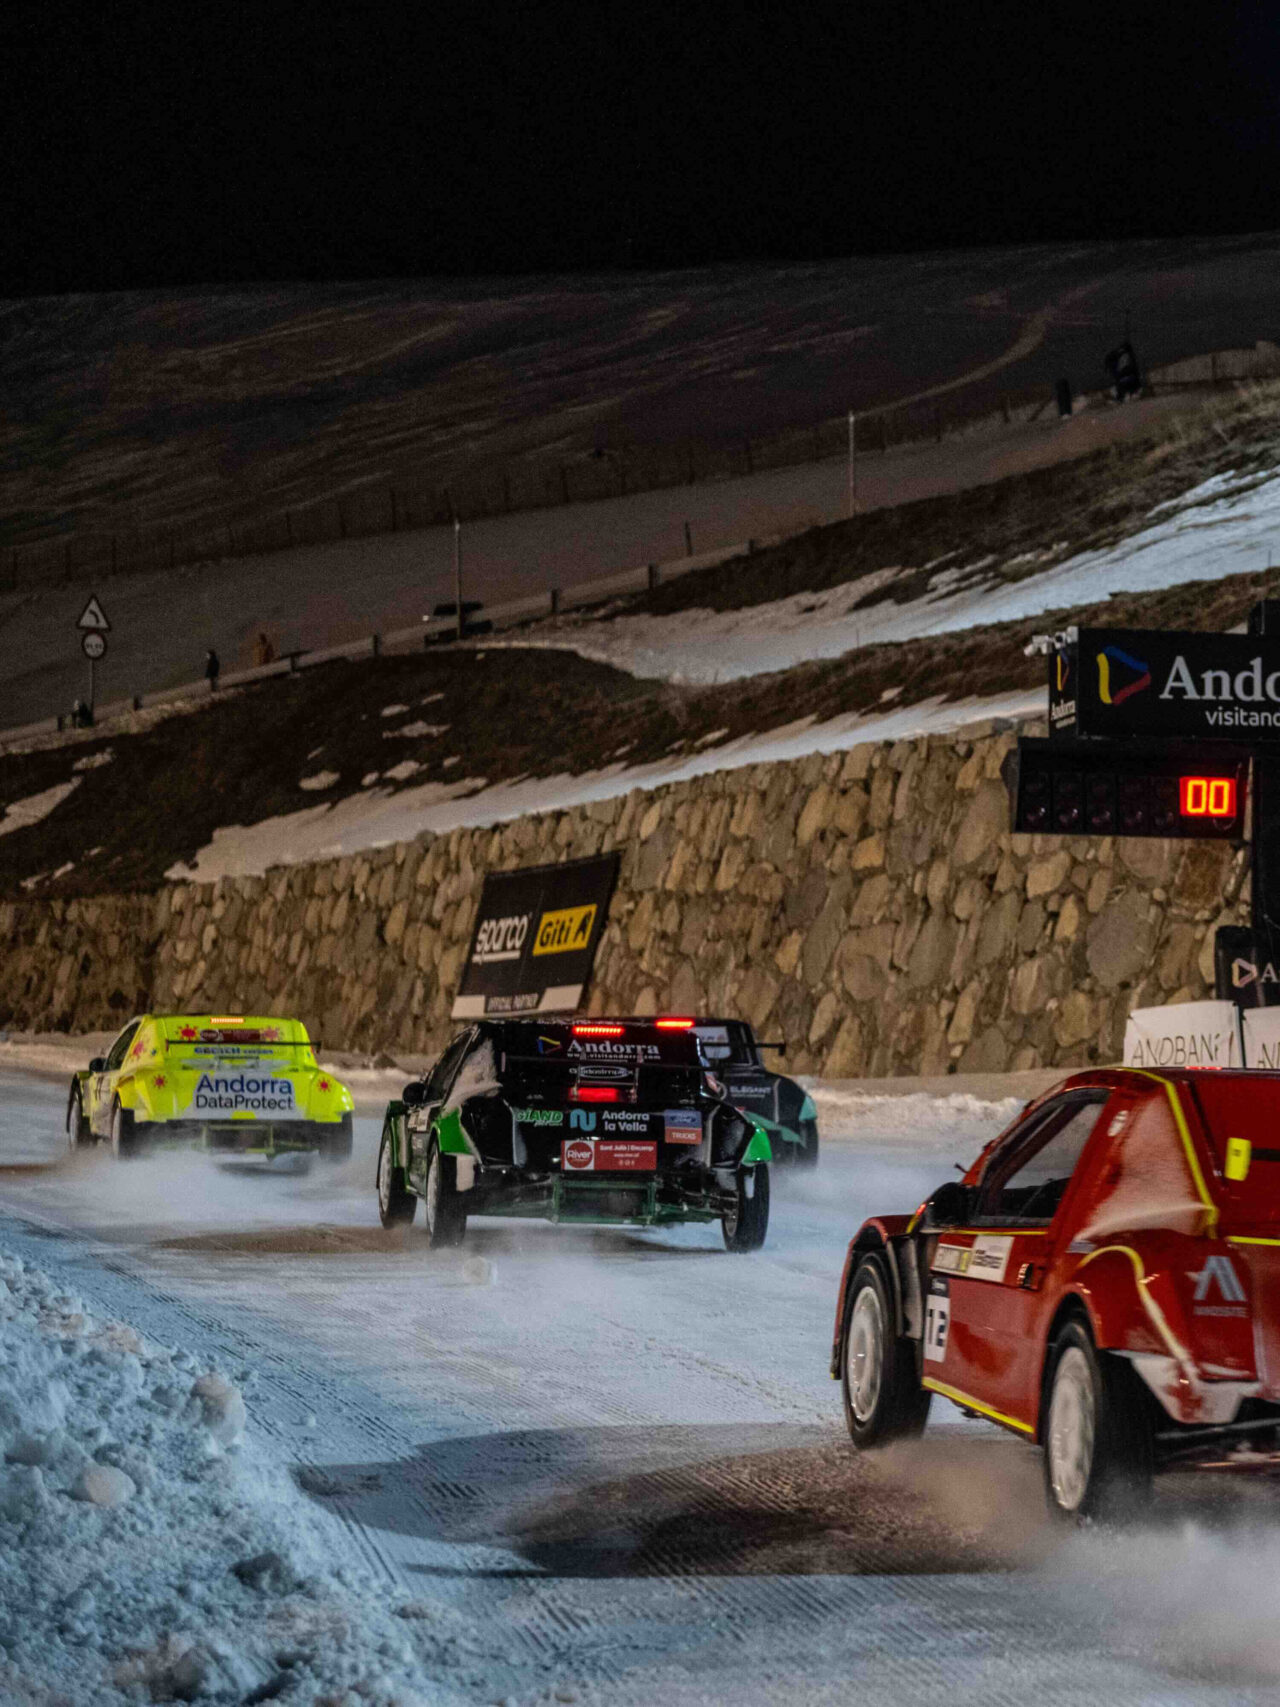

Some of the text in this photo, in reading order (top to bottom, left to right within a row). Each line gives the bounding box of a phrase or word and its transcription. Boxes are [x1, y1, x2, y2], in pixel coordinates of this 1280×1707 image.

[1187, 779, 1230, 814] 00
[474, 914, 530, 964] sparco
[538, 917, 574, 948] Giti
[567, 1040, 660, 1055] Andorra
[196, 1074, 293, 1095] Andorra
[195, 1094, 294, 1111] DataProtect
[602, 1110, 651, 1121] Andorra
[604, 1121, 648, 1132] la Vella
[567, 1150, 592, 1159] River
